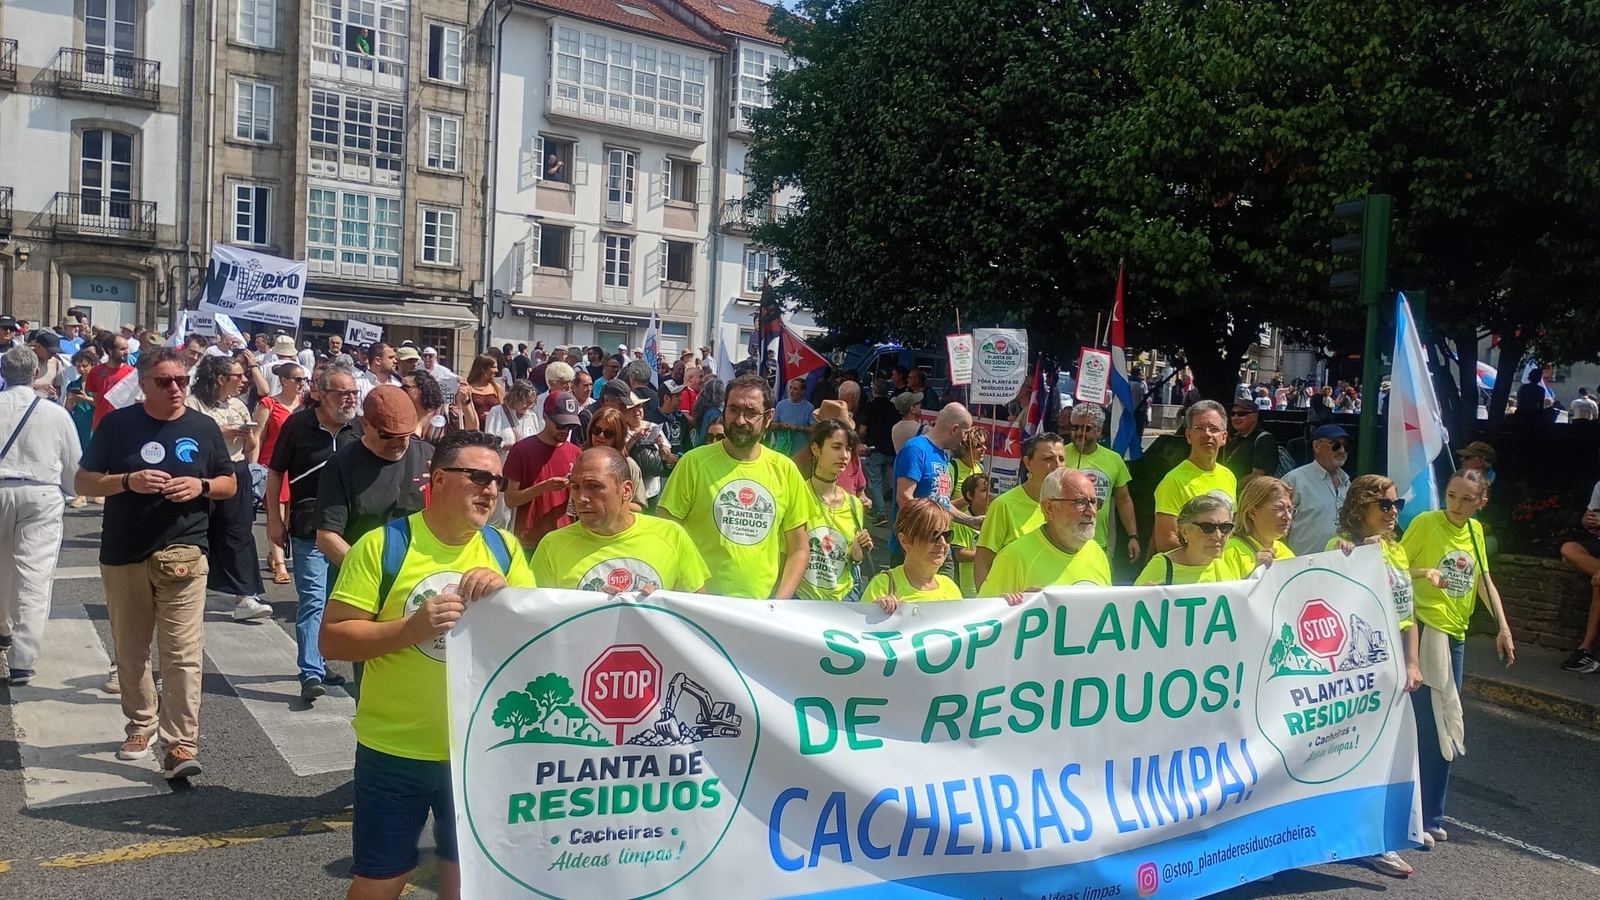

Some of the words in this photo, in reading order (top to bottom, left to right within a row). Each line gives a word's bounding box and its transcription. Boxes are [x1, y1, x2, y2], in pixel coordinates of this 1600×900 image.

[89, 283, 119, 296] 10-8
[722, 516, 768, 529] RESIDUOS
[727, 509, 753, 519] PLANTA
[610, 575, 629, 585] STOP
[818, 618, 1002, 678] STOP
[1013, 594, 1237, 660] PLANTA
[1303, 616, 1338, 642] STOP
[594, 668, 652, 700] STOP
[1290, 679, 1354, 707] PLANTA
[1358, 672, 1375, 692] DE
[793, 696, 889, 756] DE
[921, 661, 1244, 744] RESIDUOS!
[1283, 690, 1381, 736] RESIDUOS
[535, 754, 661, 785] PLANTA
[668, 750, 703, 777] DE
[507, 777, 721, 825] RESIDUOS
[768, 762, 1094, 872] CACHEIRAS
[1104, 738, 1257, 834] LIMPA!
[568, 825, 664, 845] Cacheiras
[547, 849, 610, 872] Aldeas
[617, 840, 686, 868] limpas!
[1162, 825, 1317, 883] @stop_plantaderesiduoscacheiras
[1082, 884, 1122, 900] limpas
